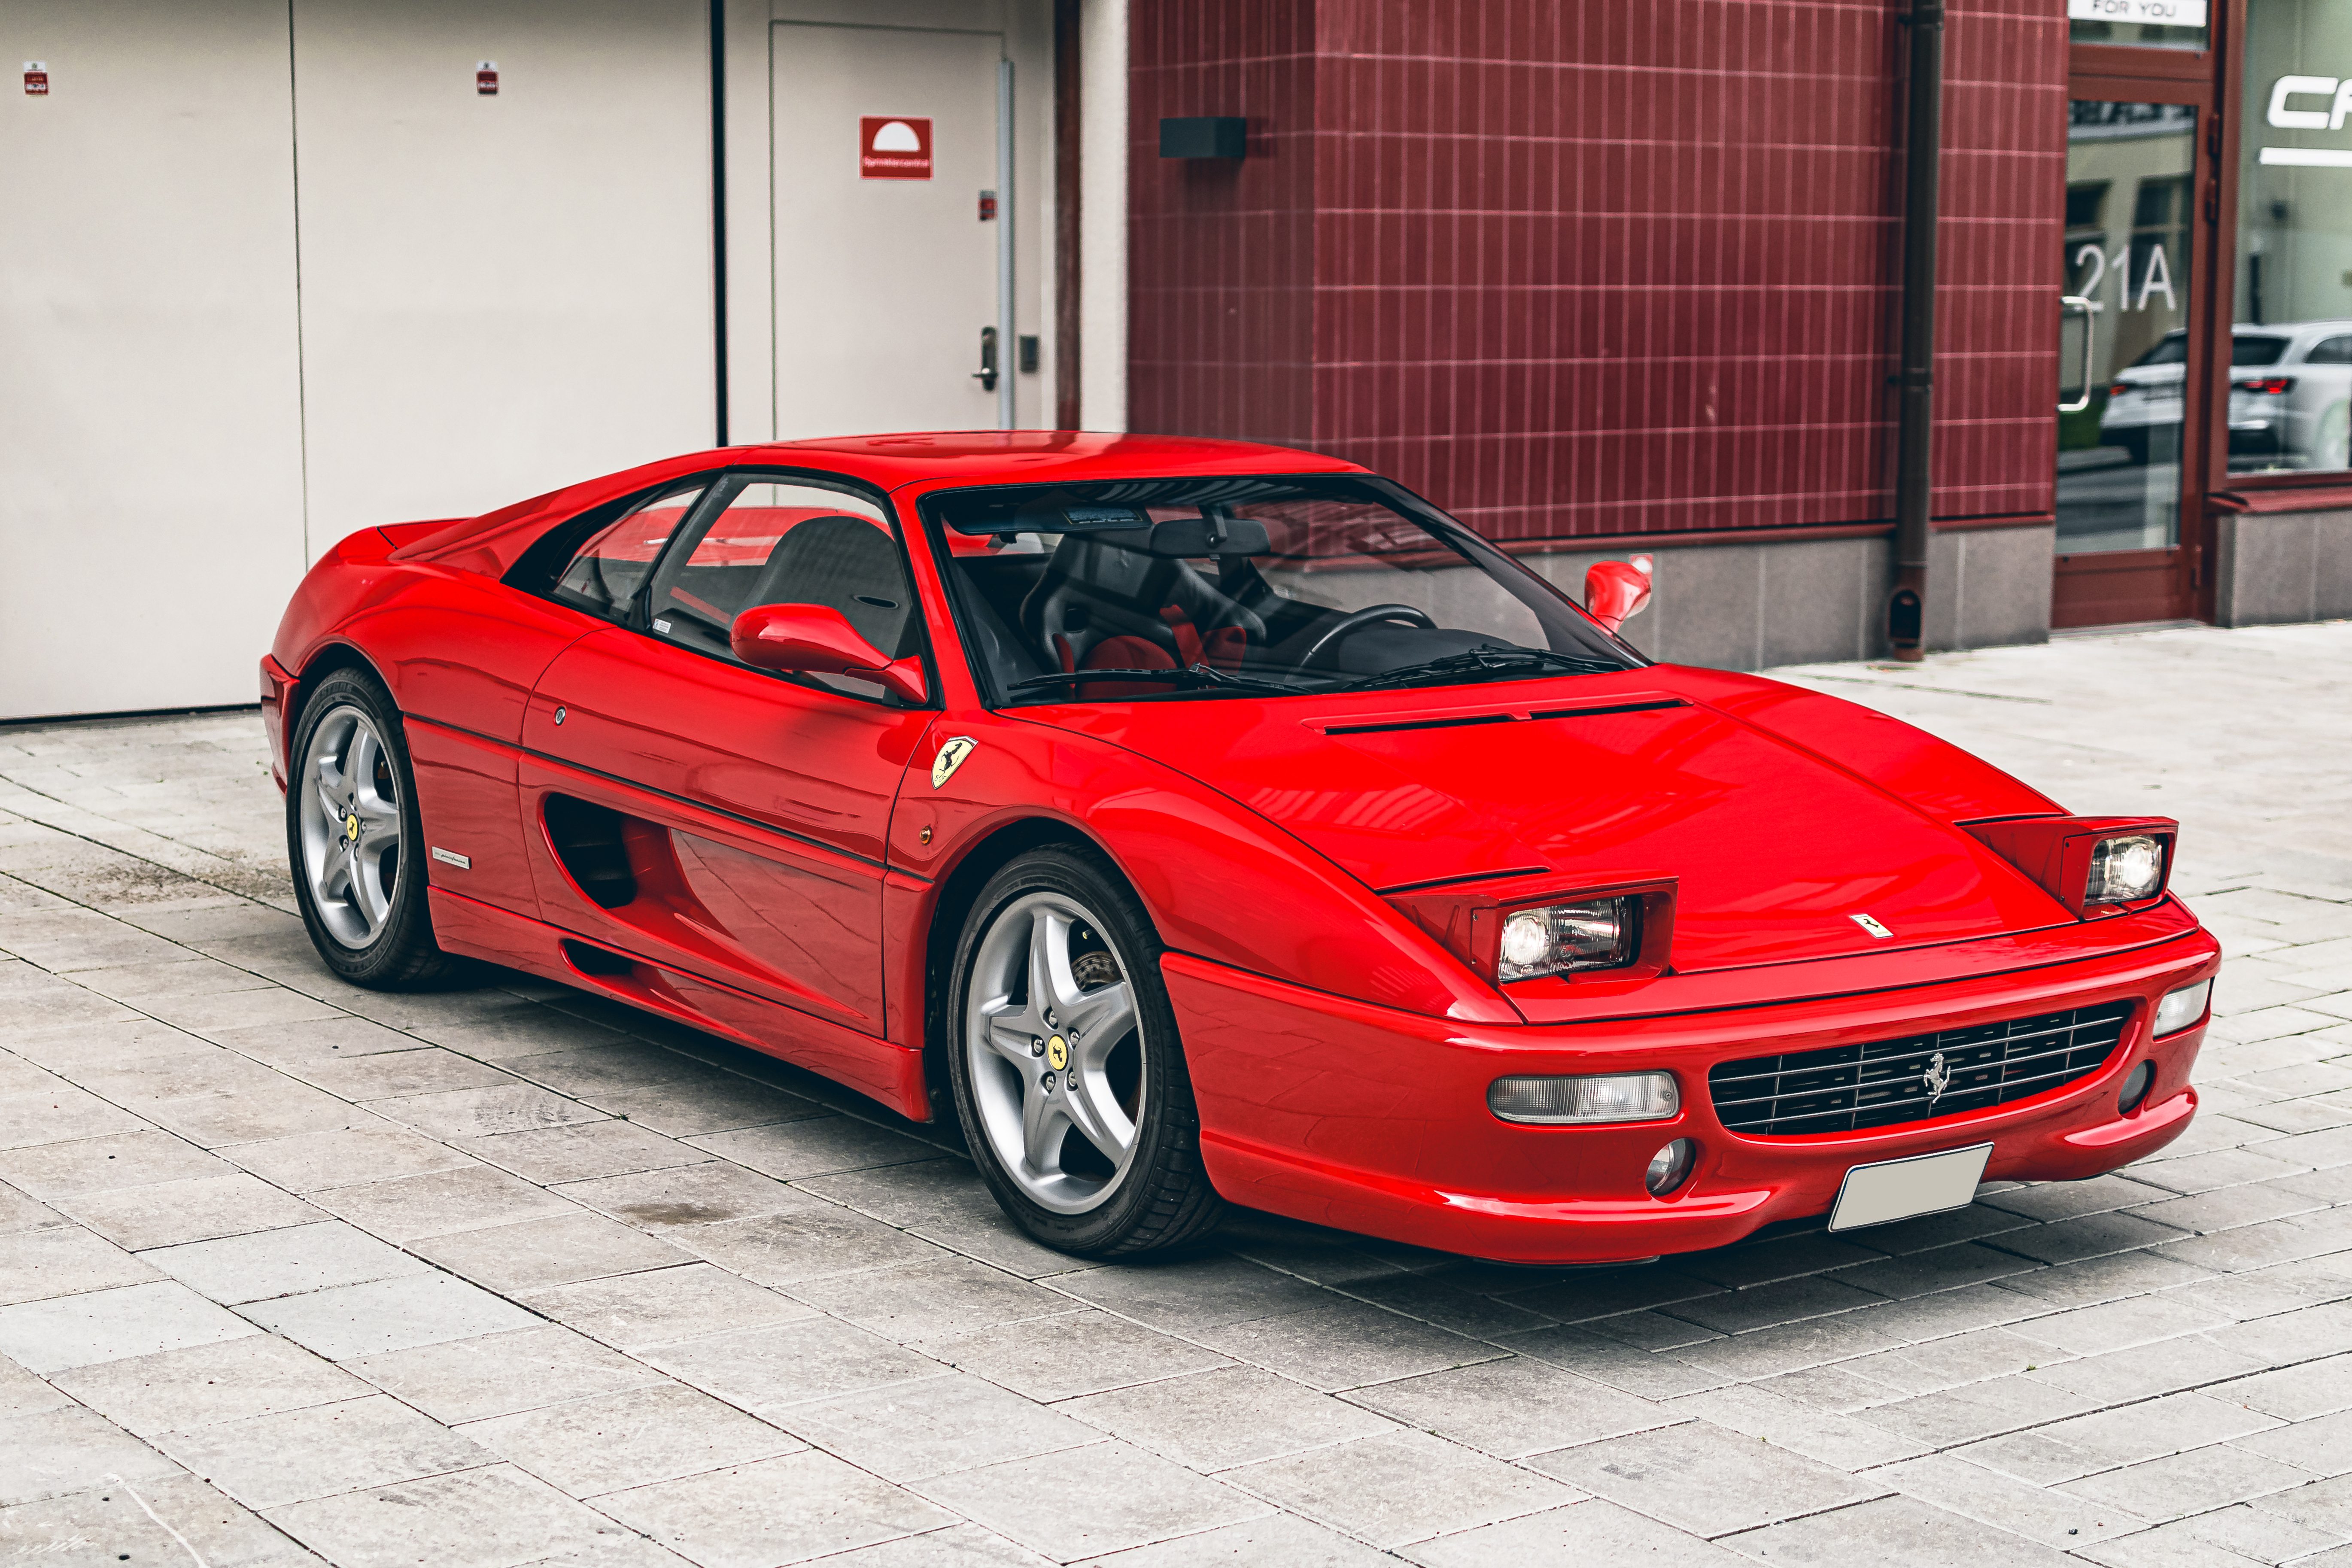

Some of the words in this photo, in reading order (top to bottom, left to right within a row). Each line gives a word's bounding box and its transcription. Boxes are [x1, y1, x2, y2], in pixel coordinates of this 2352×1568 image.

[2092, 0, 2128, 13] FOR
[2139, 3, 2176, 17] YOU
[2076, 244, 2176, 311] 21A
